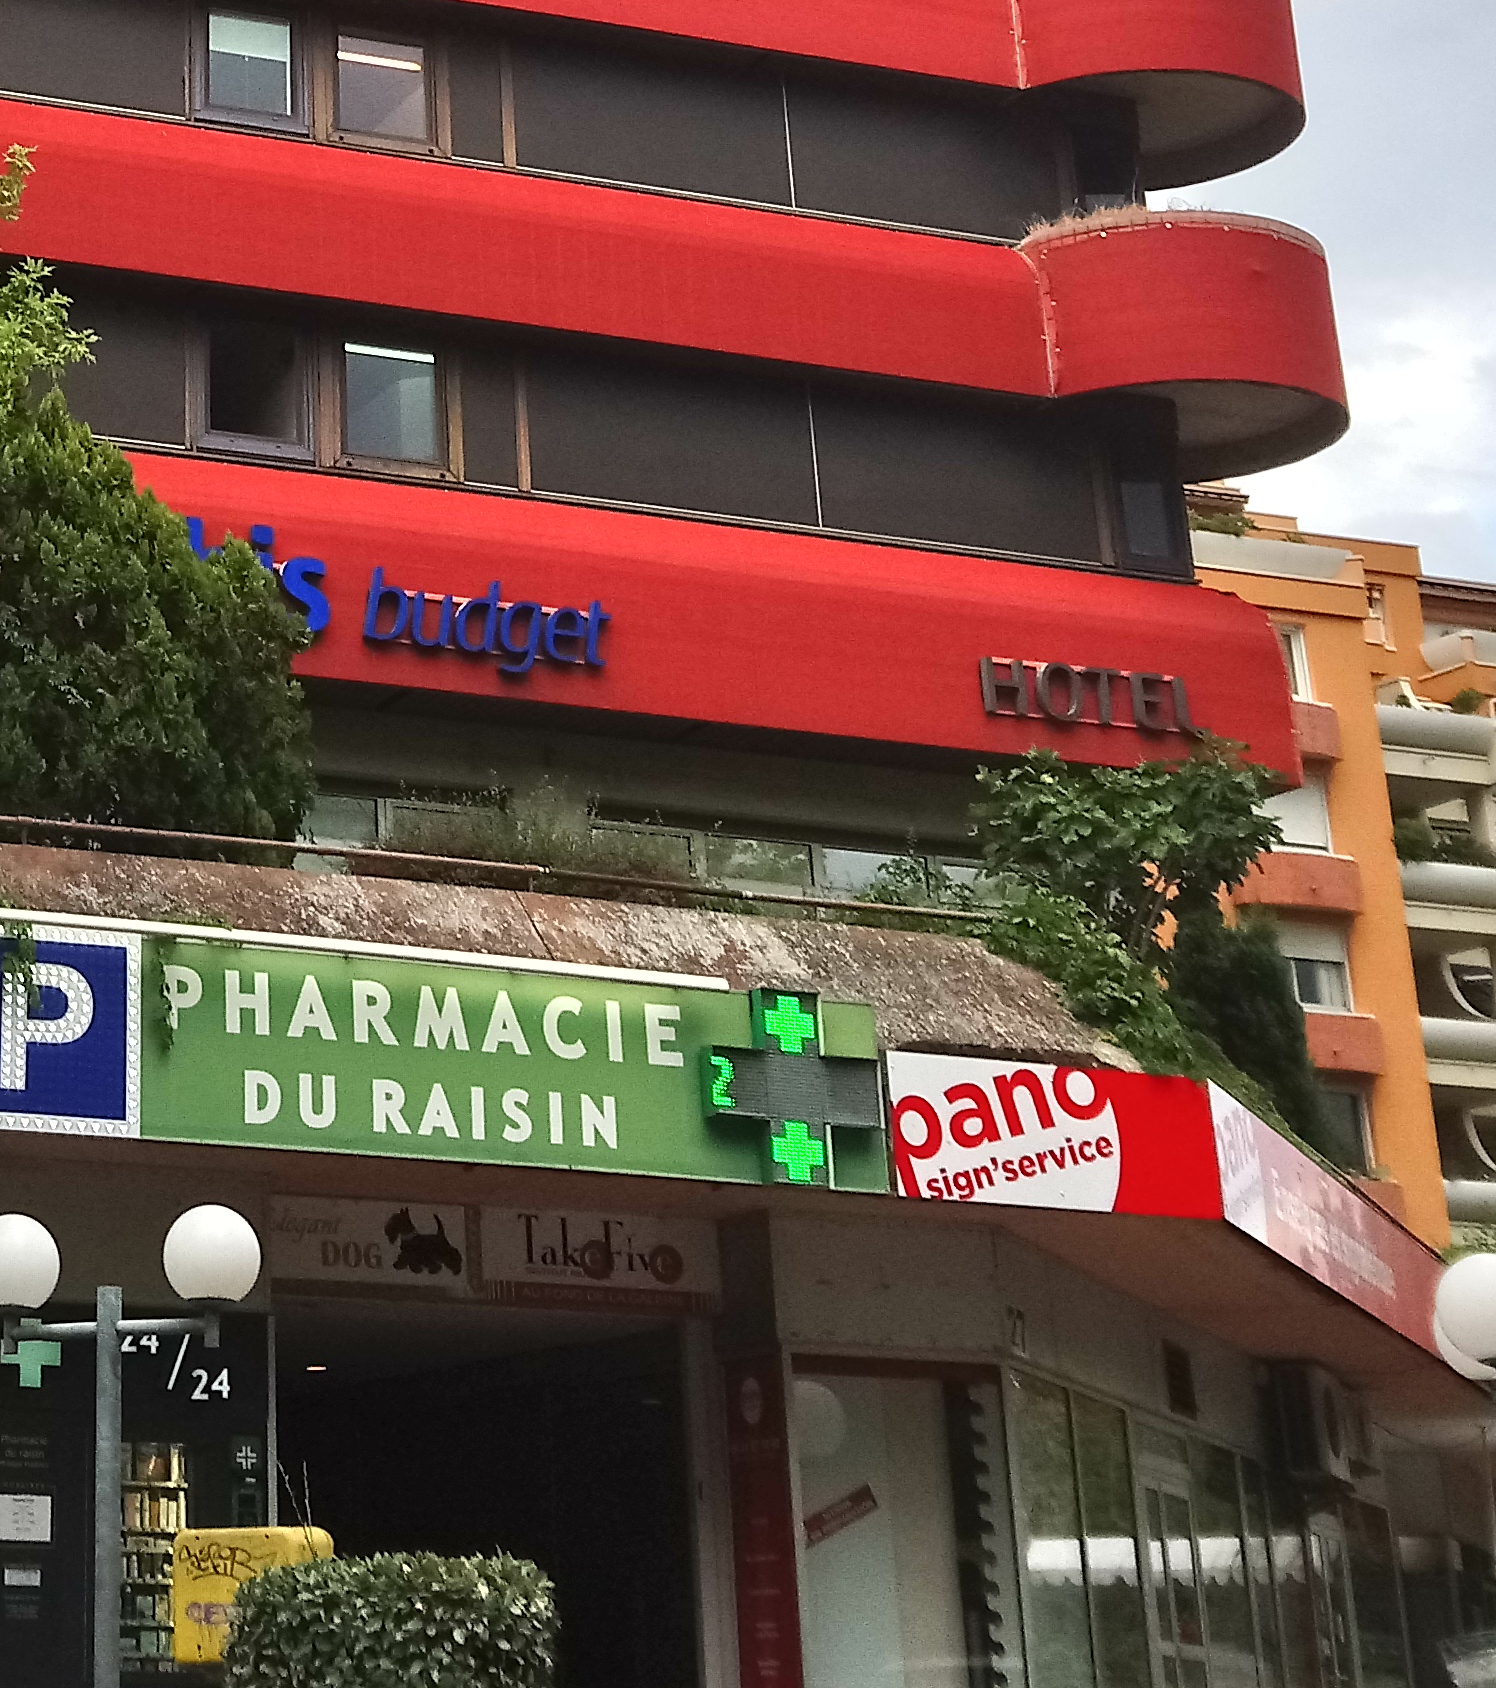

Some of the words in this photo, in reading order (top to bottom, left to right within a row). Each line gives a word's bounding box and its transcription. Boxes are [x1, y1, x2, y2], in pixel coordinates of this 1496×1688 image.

[363, 566, 612, 673] budget
[979, 656, 1205, 741] HOTEL
[0, 962, 94, 1091] P
[162, 963, 685, 1068] PHARMACIE
[243, 1069, 336, 1129] DU
[371, 1078, 619, 1149] RAISIN
[890, 1068, 1109, 1198] pano
[320, 1240, 383, 1269] DOG
